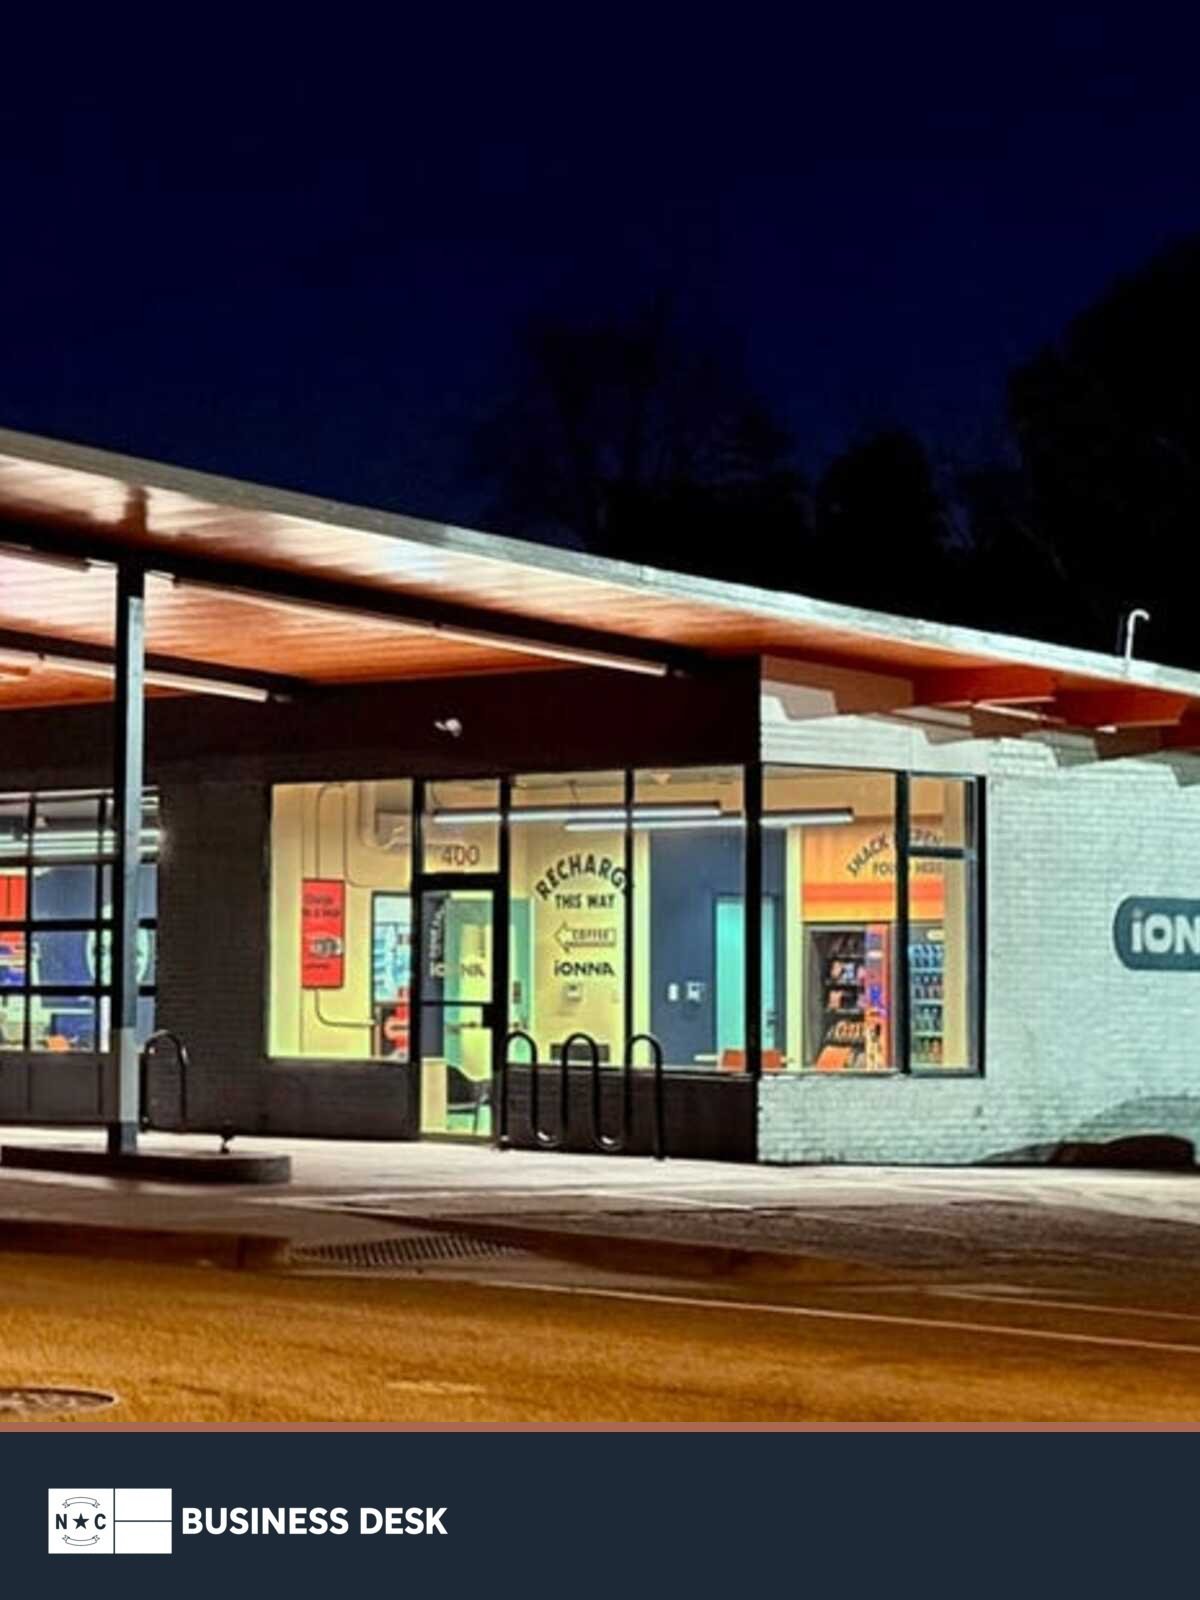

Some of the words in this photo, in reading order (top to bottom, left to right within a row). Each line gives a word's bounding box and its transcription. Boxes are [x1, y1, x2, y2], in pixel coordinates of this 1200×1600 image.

[440, 844, 481, 866] 400
[555, 894, 582, 909] THIS
[586, 894, 615, 909] WAY
